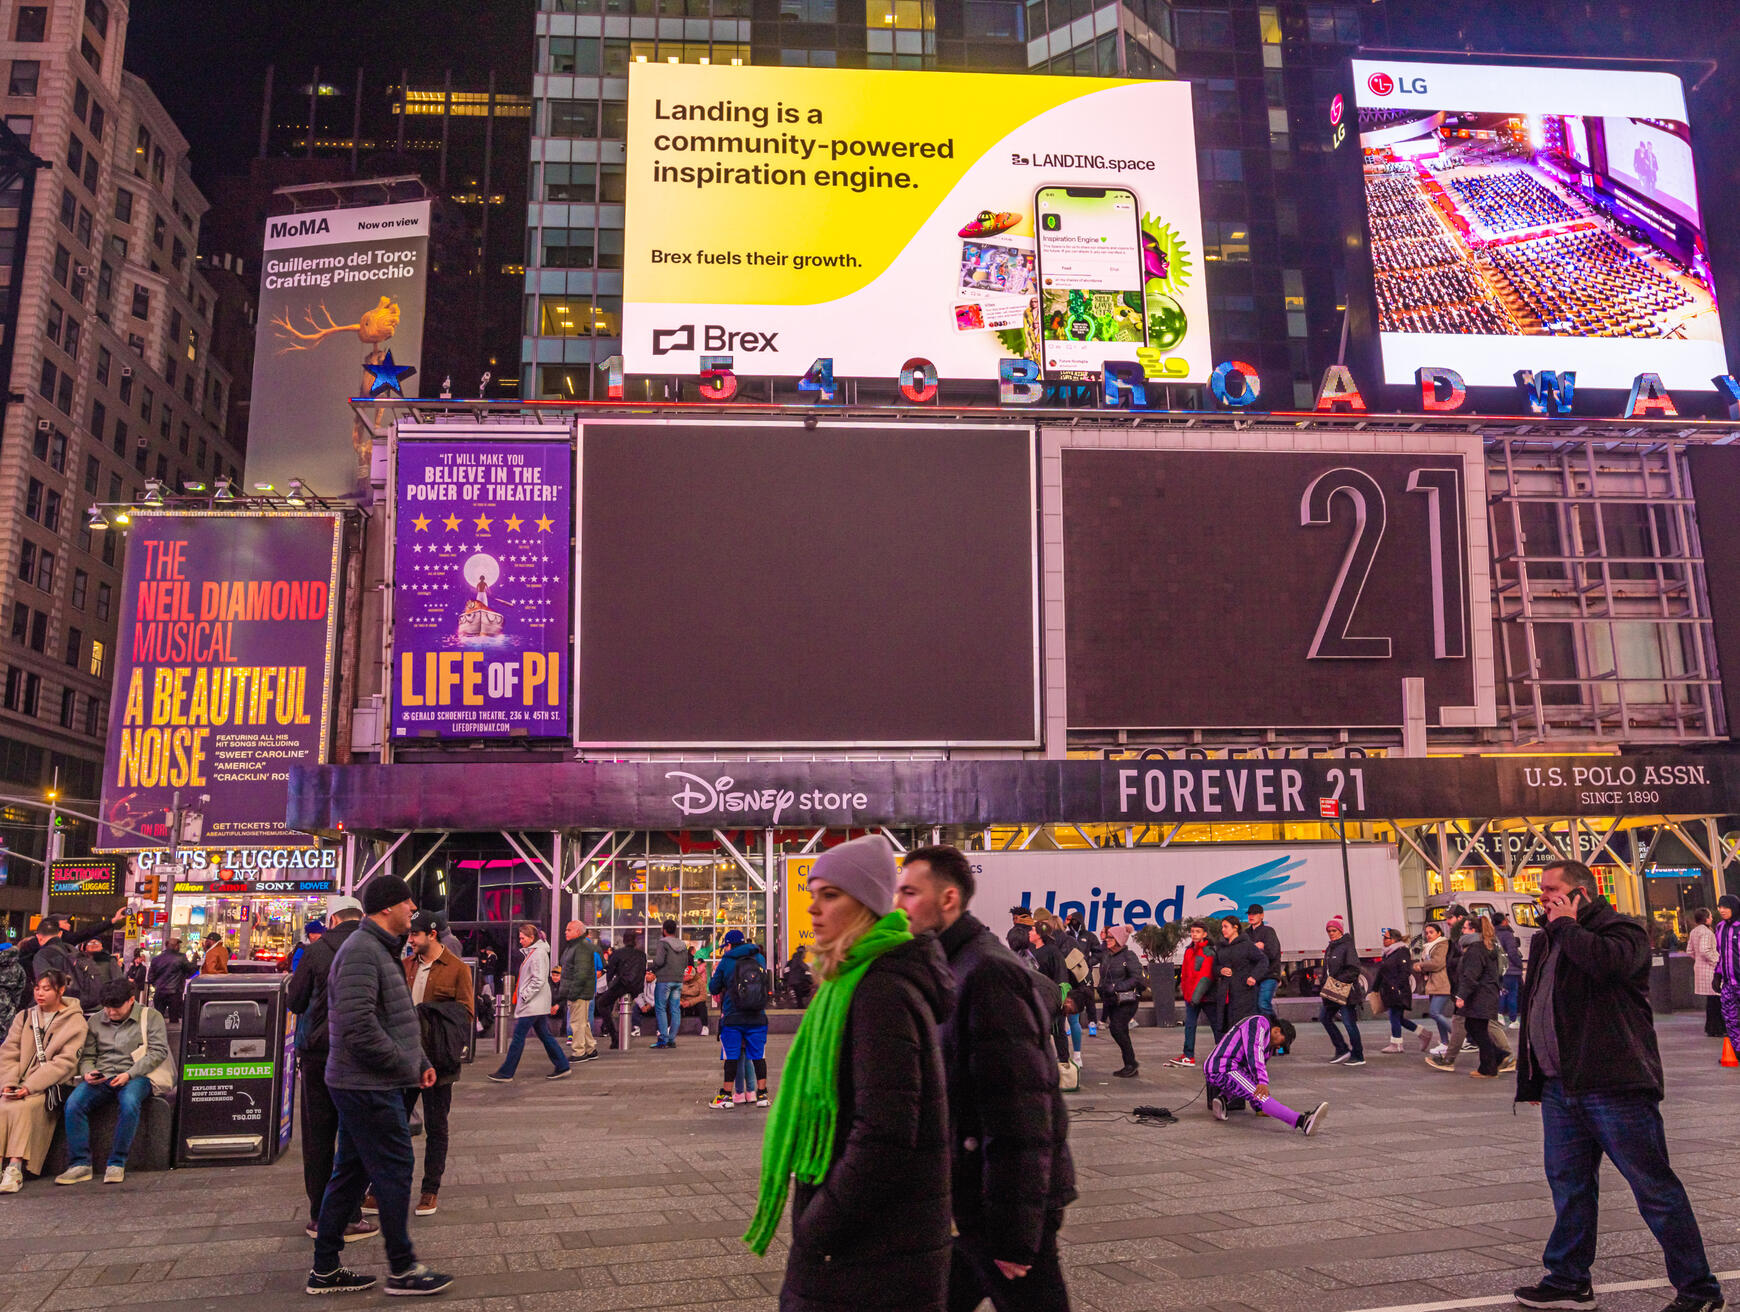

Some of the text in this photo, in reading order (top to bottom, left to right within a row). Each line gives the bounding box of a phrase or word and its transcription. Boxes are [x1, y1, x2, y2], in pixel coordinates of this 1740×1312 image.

[1398, 77, 1427, 94] LG
[655, 99, 823, 127] Landing is a
[653, 130, 955, 160] community-powered
[1333, 123, 1345, 149] LG
[1032, 153, 1156, 172] LANDING.space
[653, 160, 920, 193] inspiration engine.
[270, 217, 330, 239] MoMA
[358, 217, 419, 230] Now on view
[267, 250, 417, 275] Guillermo del Toro:
[651, 248, 863, 271] Brex fuels their growth.
[265, 264, 414, 290] Crafting Pinocchio
[703, 325, 779, 354] Brex
[456, 453, 477, 465] WILL
[480, 454, 504, 465] MAKE
[507, 454, 524, 465] YOU
[425, 466, 542, 483] BELIEVE IN THE
[407, 484, 457, 501] POWER
[463, 484, 481, 500] OF
[143, 540, 188, 580] THE
[1301, 467, 1466, 659] 21
[137, 580, 329, 621] NEIL DIAMOND
[132, 621, 238, 663] MUSICAL
[401, 652, 559, 706] LIFE OF PI
[123, 665, 311, 726] A BEAUTIFUL
[411, 711, 435, 720] GERALD
[437, 711, 477, 720] SCHOENFELD
[510, 711, 522, 720] 236
[533, 711, 549, 720] 45TH
[452, 723, 510, 732] LIFEOFPIBWAY.COM
[117, 727, 211, 788] NOISE
[1523, 765, 1711, 787] U.S. POLO ASSN.
[799, 789, 868, 810] store
[1119, 768, 1366, 813] FOREVER 21
[1581, 790, 1660, 804] SINCE 1890
[138, 849, 336, 869] GITS LUGGAGE
[54, 868, 110, 880] ELECTRONICS
[82, 882, 110, 891] LUGGAGE
[174, 882, 204, 892] Nikon
[209, 882, 248, 892] Canon
[256, 882, 295, 891] SONY
[300, 882, 329, 890] BOWER
[127, 914, 137, 936] ATM
[186, 1066, 271, 1077] TIMES SQUARE
